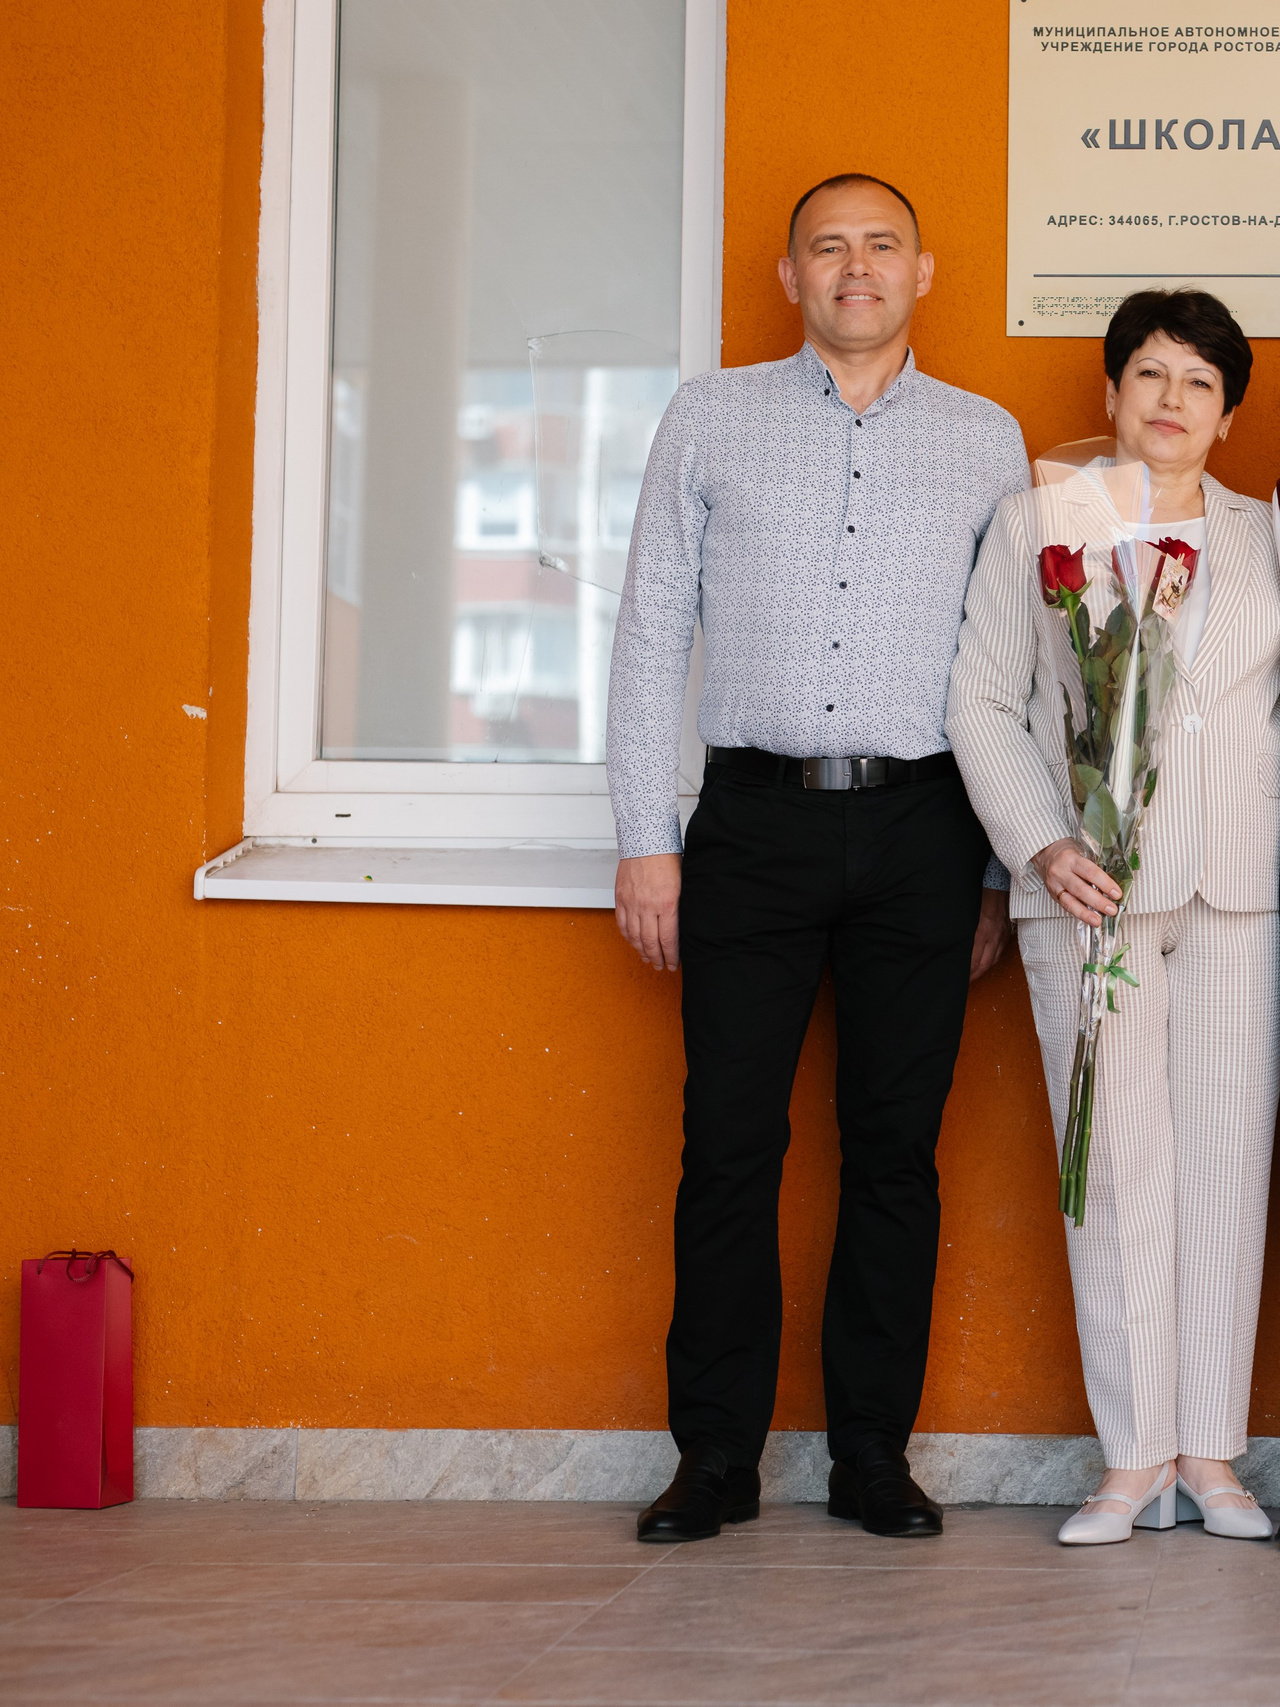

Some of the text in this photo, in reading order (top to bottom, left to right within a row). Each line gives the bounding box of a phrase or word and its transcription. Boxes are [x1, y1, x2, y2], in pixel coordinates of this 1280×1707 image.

[1032, 26, 1170, 39] МУНИЦИПАЛЬНОЕ
[1174, 26, 1280, 38] АВТОНОМНОЕ
[1040, 41, 1144, 54] УЧРЕЖДЕНИЕ
[1148, 41, 1209, 54] ГОРОДА
[1047, 214, 1103, 227] АДРЕС:
[1108, 214, 1163, 228] 344065,
